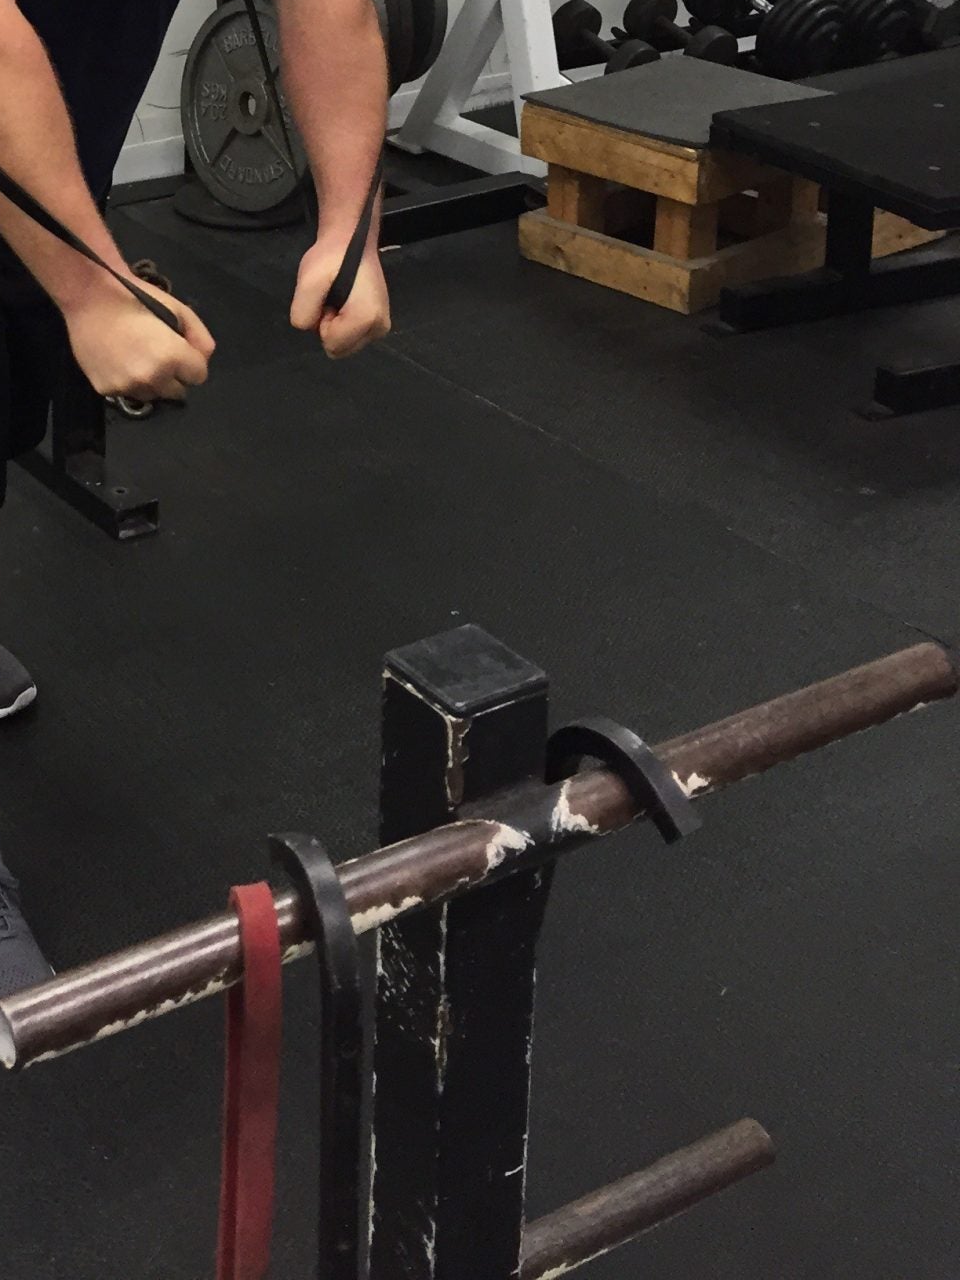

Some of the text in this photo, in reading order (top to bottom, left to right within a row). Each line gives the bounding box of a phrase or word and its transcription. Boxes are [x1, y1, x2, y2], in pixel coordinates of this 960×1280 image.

[223, 29, 278, 53] BARBLL
[200, 82, 227, 101] KGS
[219, 154, 284, 184] STANDARD
